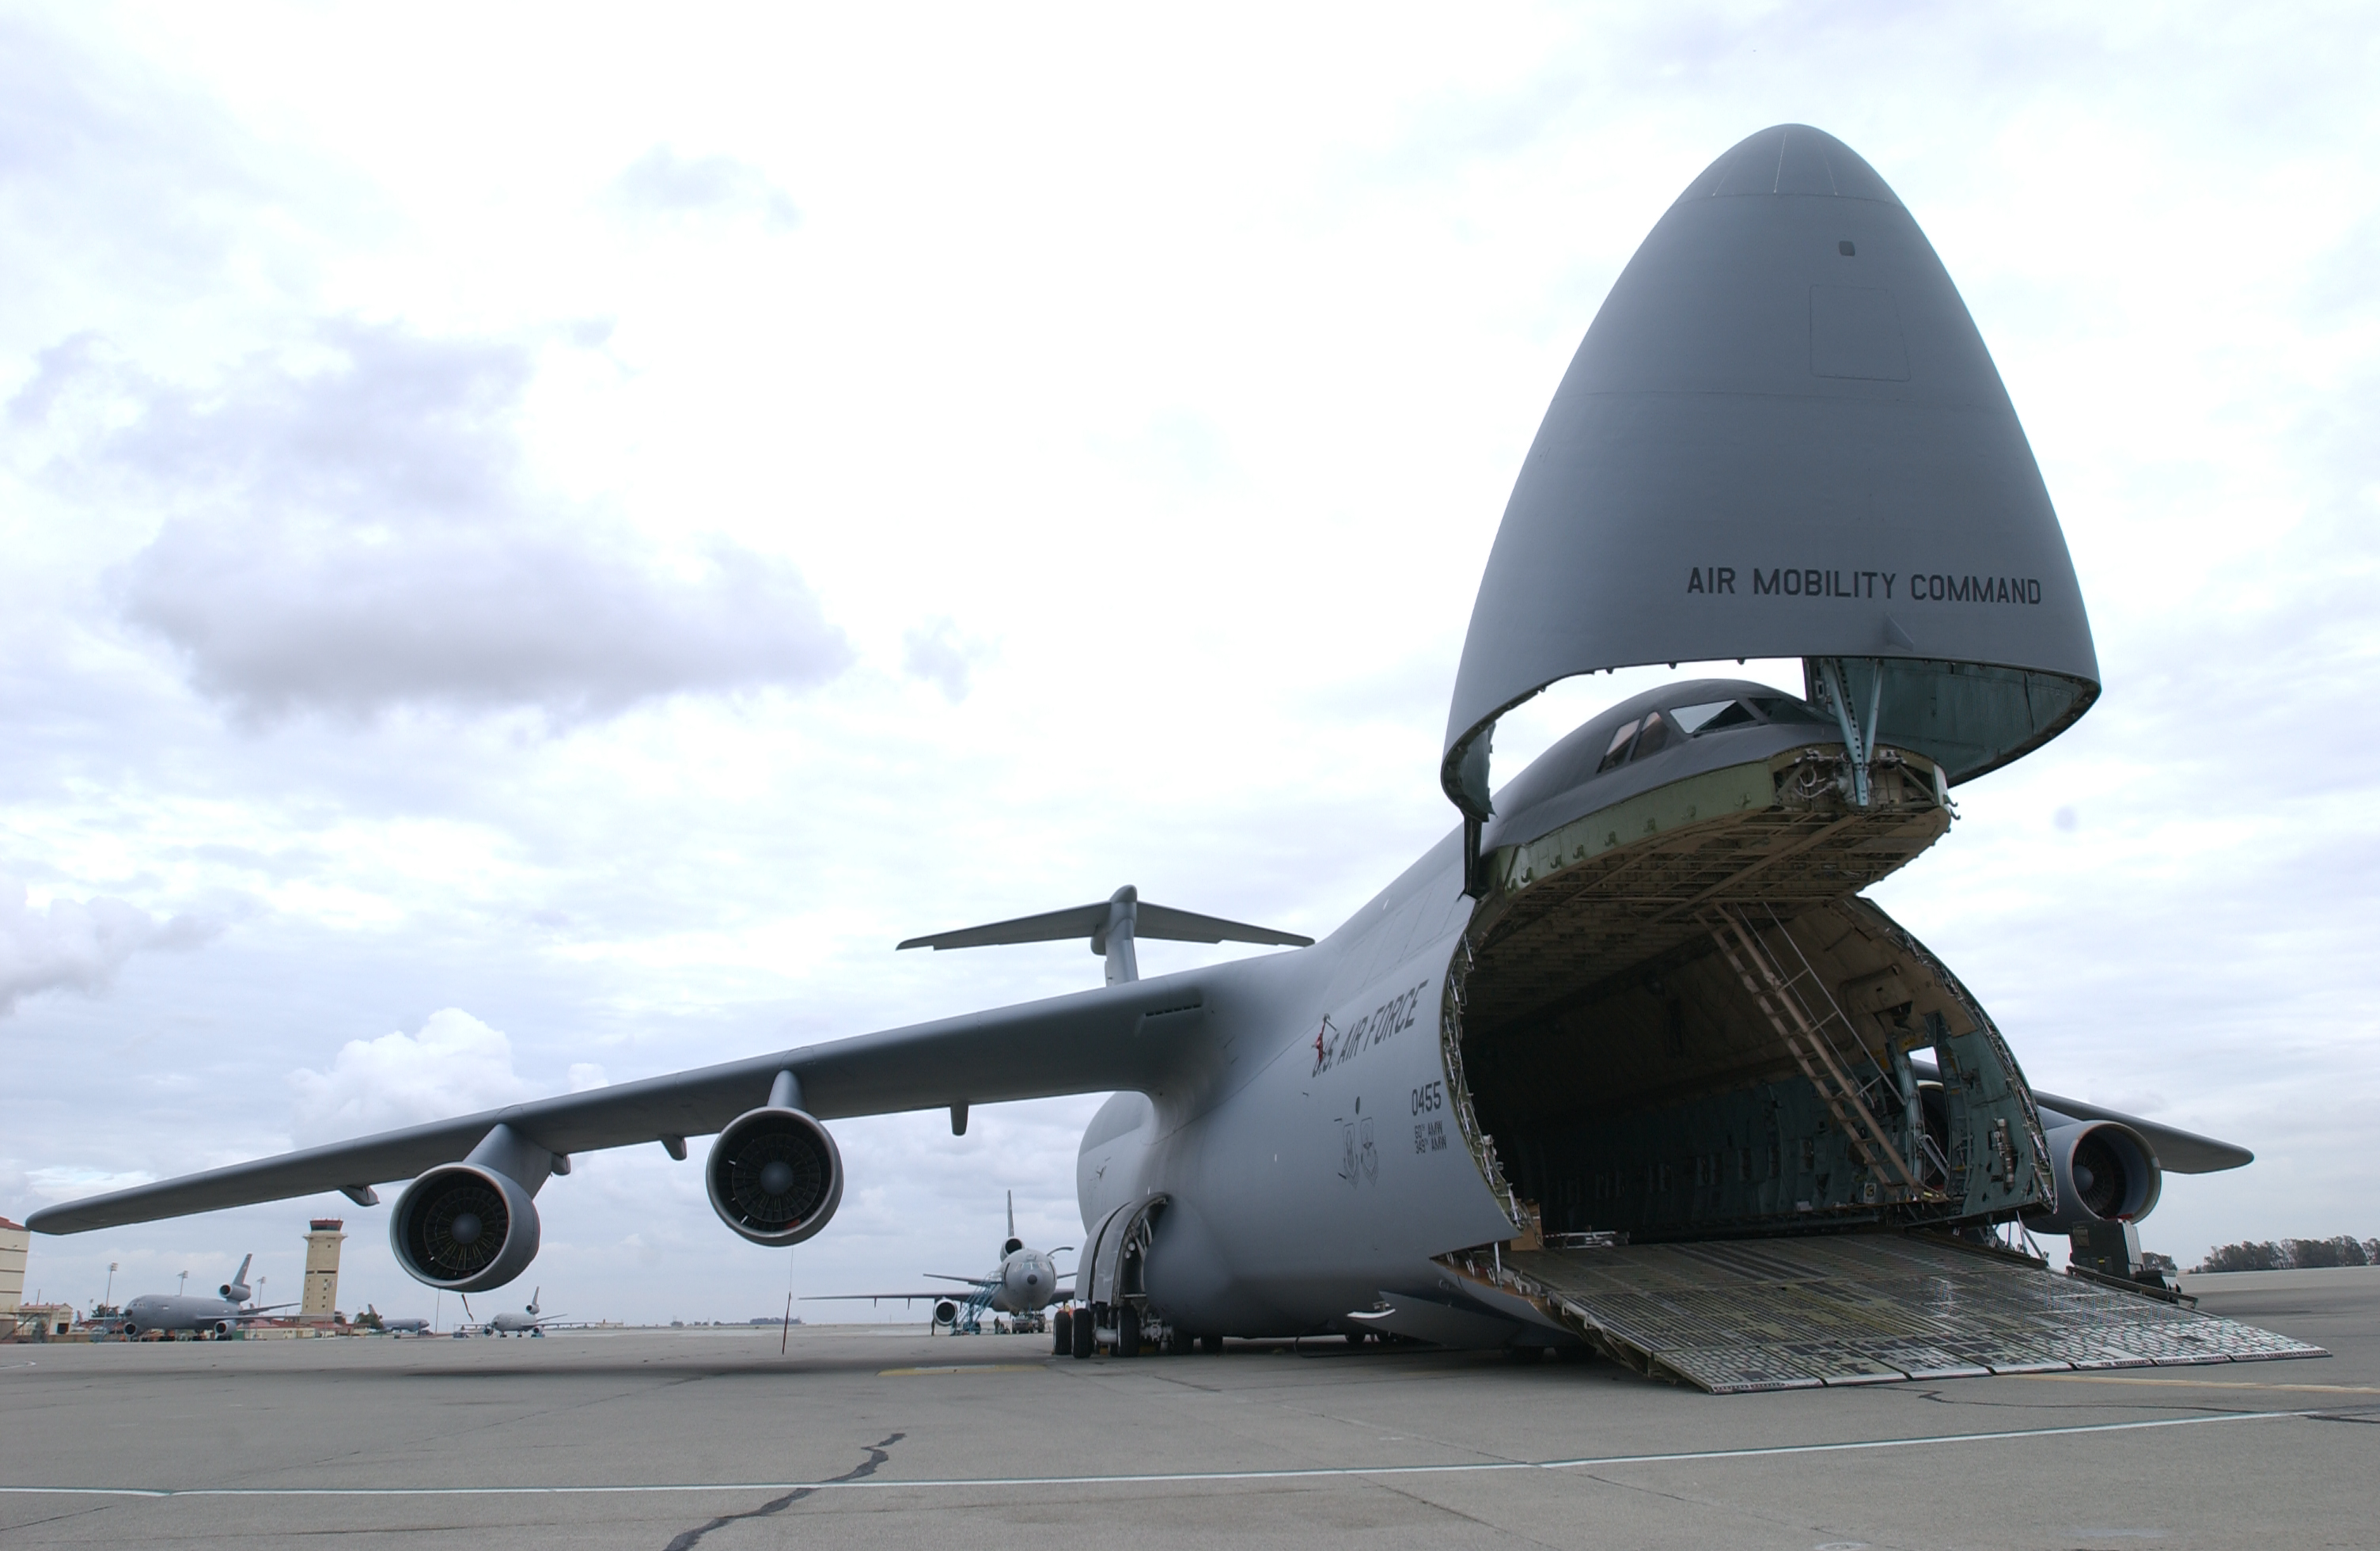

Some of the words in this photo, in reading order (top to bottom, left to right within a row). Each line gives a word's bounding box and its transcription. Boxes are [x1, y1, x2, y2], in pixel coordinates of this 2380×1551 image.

[1687, 567, 1736, 593] AIR
[1753, 568, 1897, 599] MOBILITY
[1911, 574, 2041, 605] COMMAND
[1337, 1015, 1369, 1066] AIR
[1363, 979, 1429, 1052] FORCE
[1412, 1080, 1442, 1116] 0455
[1427, 1121, 1443, 1137] AMW
[1431, 1134, 1447, 1152] AMW
